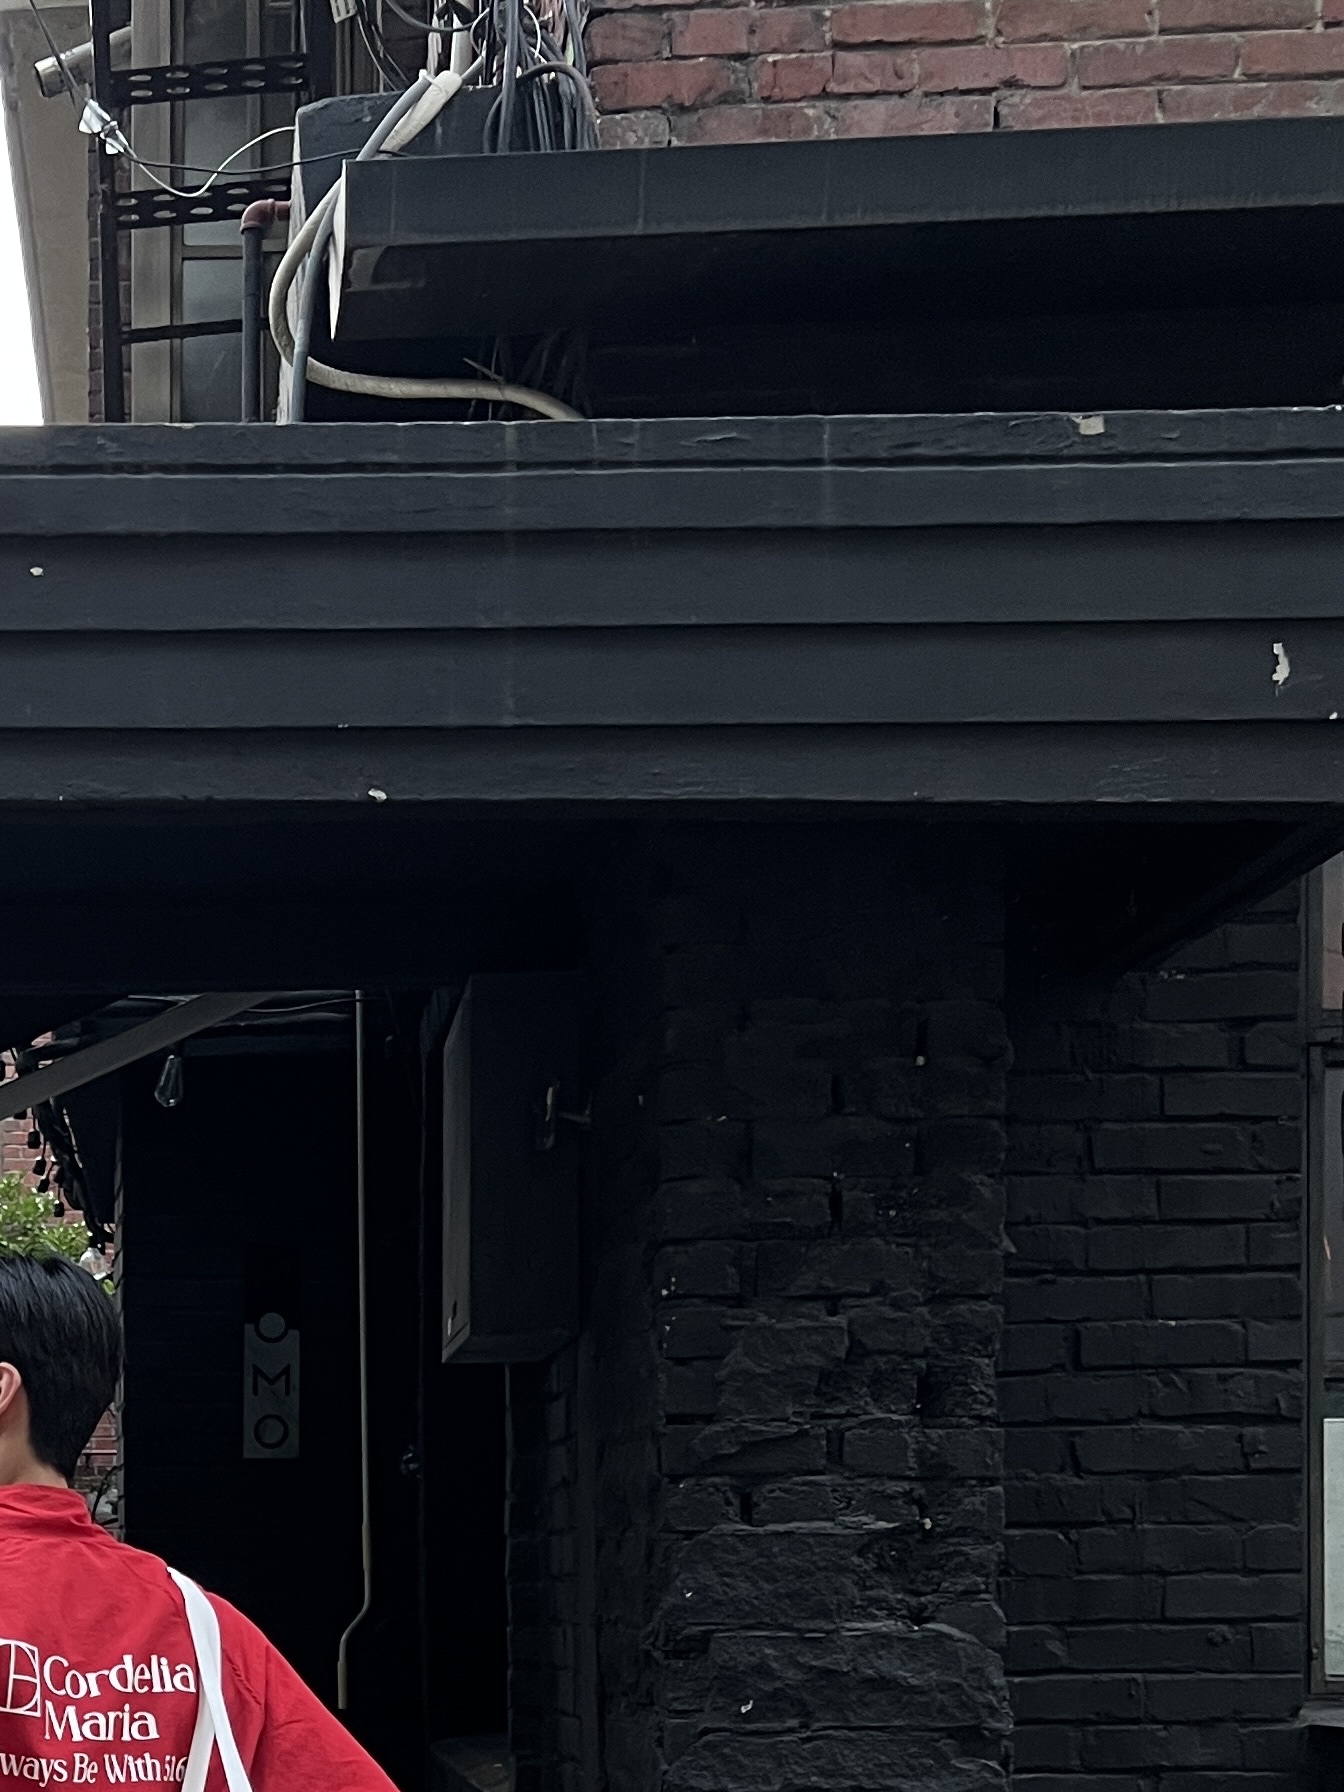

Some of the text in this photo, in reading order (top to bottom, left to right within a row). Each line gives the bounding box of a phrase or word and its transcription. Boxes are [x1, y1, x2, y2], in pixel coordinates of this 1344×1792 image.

[43, 1654, 197, 1699] Cordelia
[44, 1700, 160, 1742] Maria
[72, 1752, 98, 1784] Be
